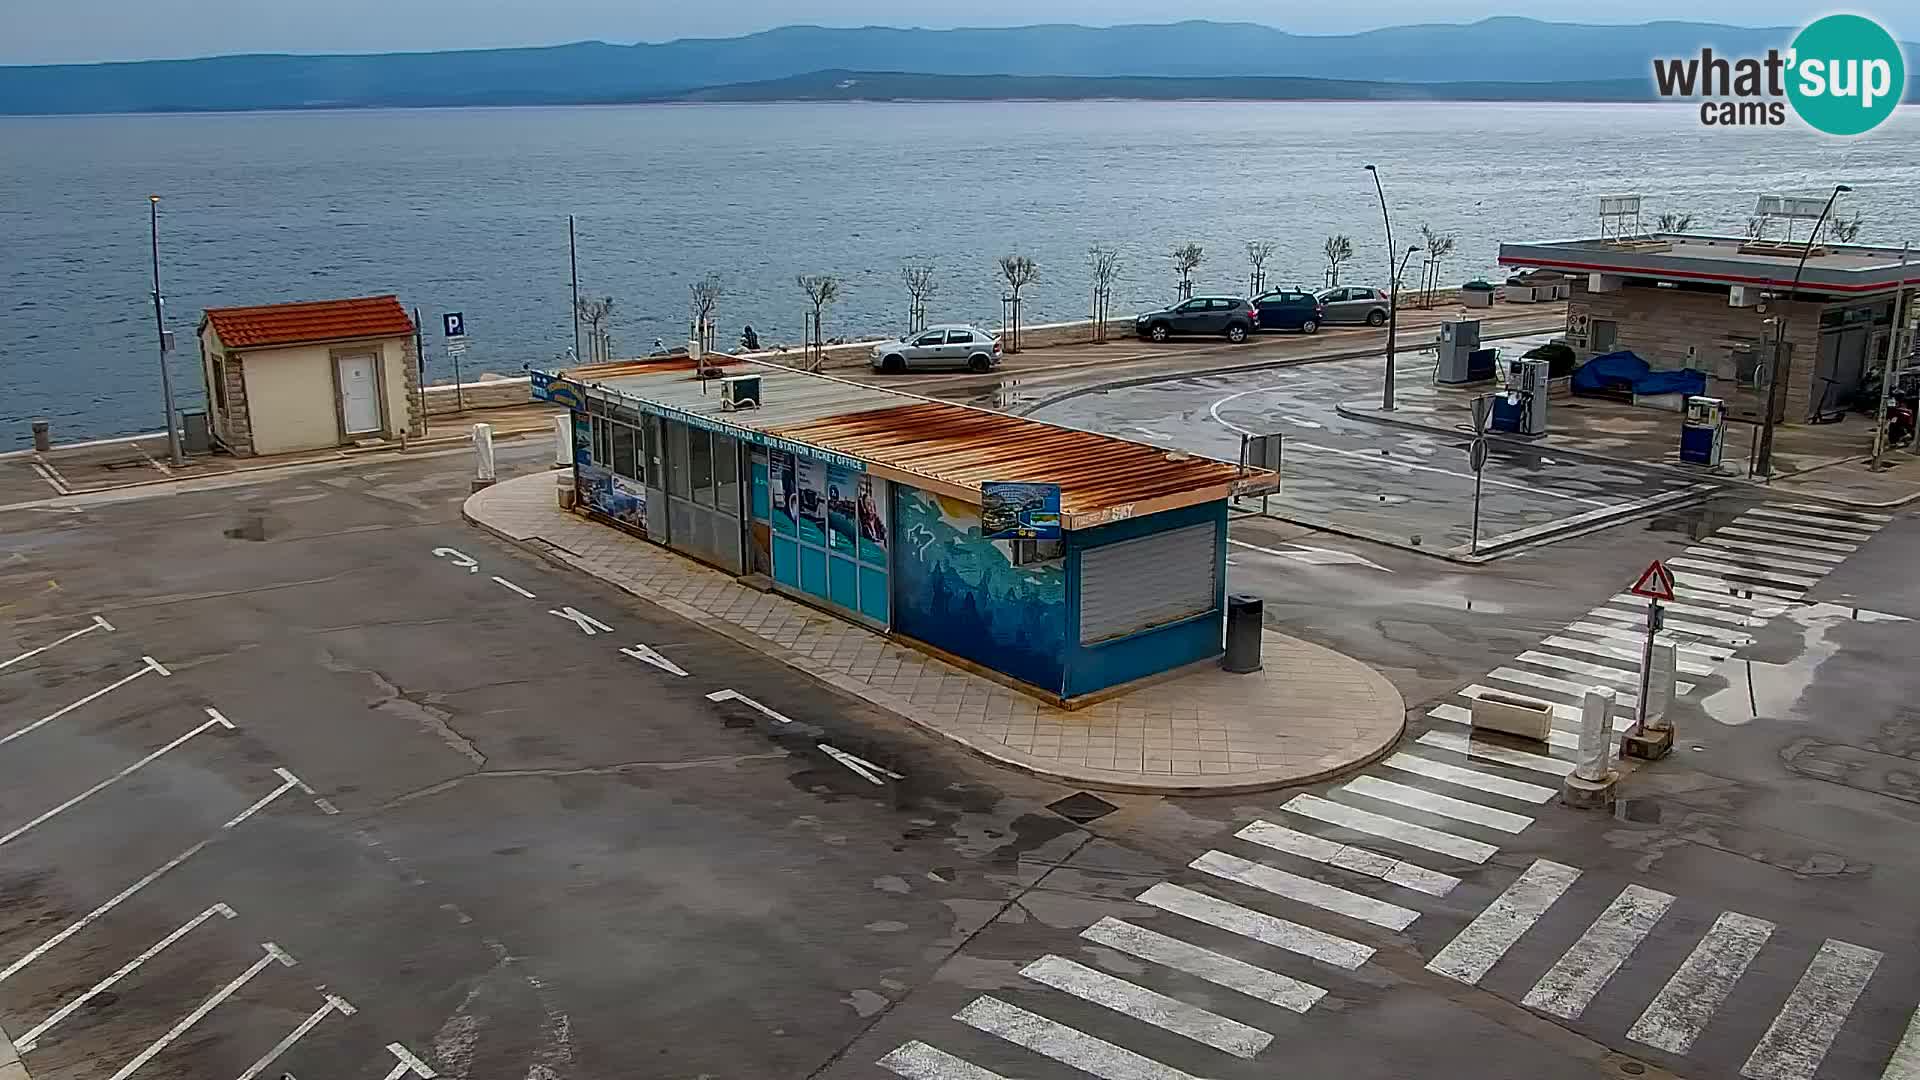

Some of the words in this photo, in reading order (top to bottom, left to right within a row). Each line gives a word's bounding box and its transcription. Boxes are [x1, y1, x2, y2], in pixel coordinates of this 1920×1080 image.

[448, 316, 459, 333] P
[725, 426, 754, 441] POSTAJA
[764, 436, 778, 449] BUS
[778, 439, 810, 454] STATION
[810, 448, 836, 463] TICKET
[836, 454, 862, 469] OFFICE
